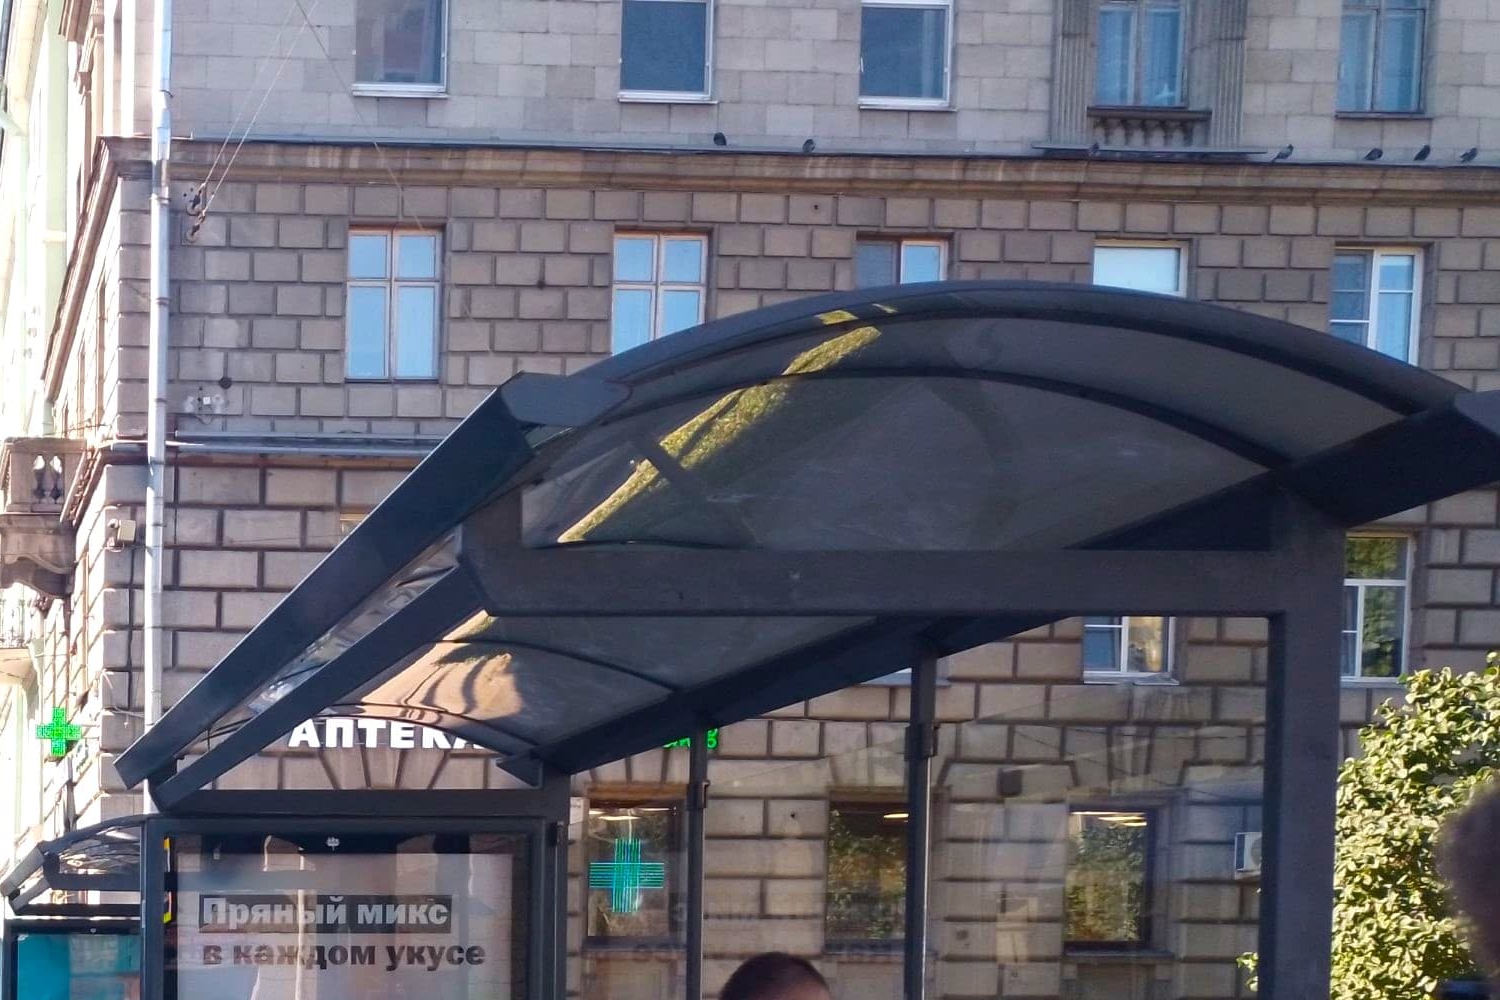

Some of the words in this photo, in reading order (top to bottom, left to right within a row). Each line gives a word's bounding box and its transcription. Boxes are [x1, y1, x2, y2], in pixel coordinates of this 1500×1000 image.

[203, 896, 347, 929] Пряный
[357, 902, 448, 925] микс
[203, 945, 222, 966] в
[233, 945, 376, 969] каждом
[386, 945, 486, 972] укусе
